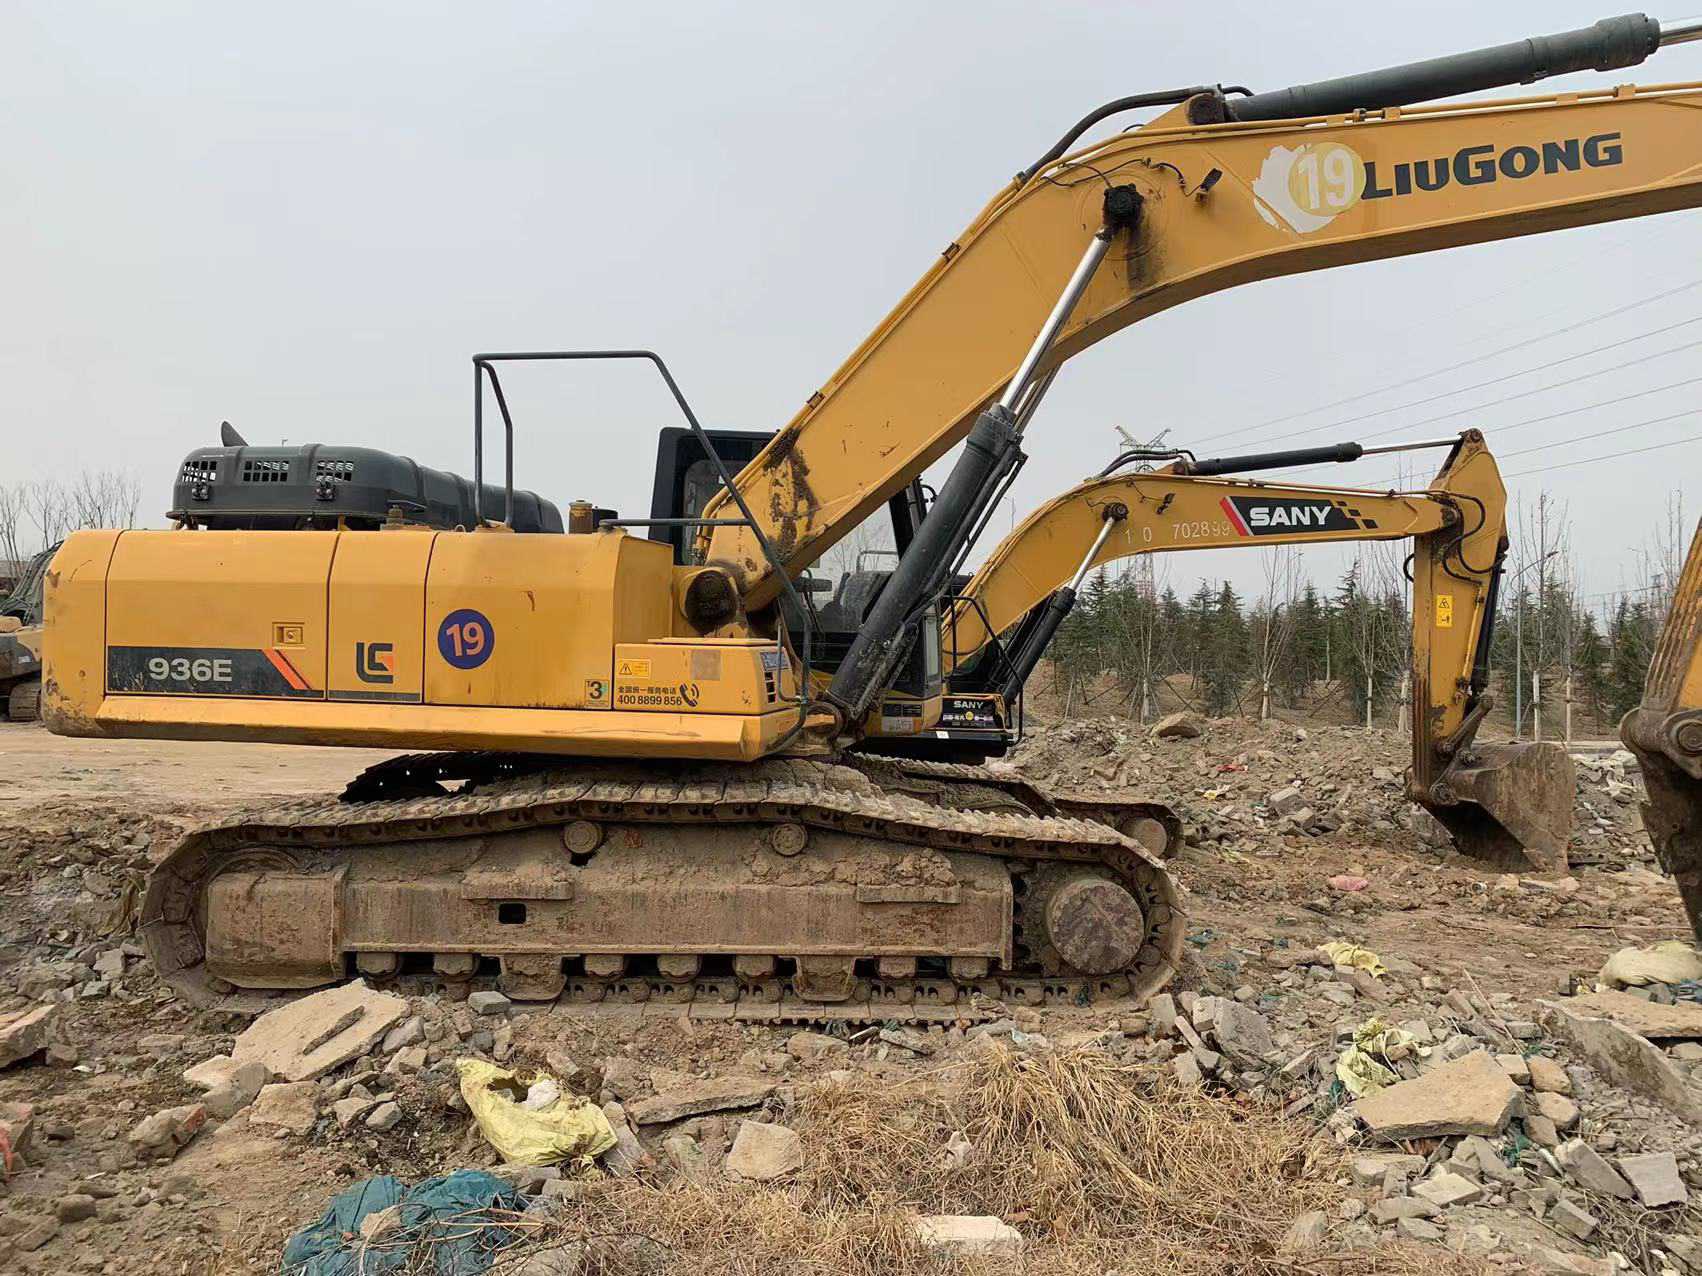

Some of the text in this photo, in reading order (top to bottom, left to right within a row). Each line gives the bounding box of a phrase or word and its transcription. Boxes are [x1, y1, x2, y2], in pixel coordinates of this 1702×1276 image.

[1361, 132, 1623, 200] LIUGONG
[1299, 149, 1354, 211] 19
[1249, 506, 1332, 527] SANY
[446, 622, 486, 657] 19
[148, 657, 233, 683] 936E
[617, 694, 636, 705] 400
[638, 695, 662, 706] 8899
[953, 700, 984, 709] SANY
